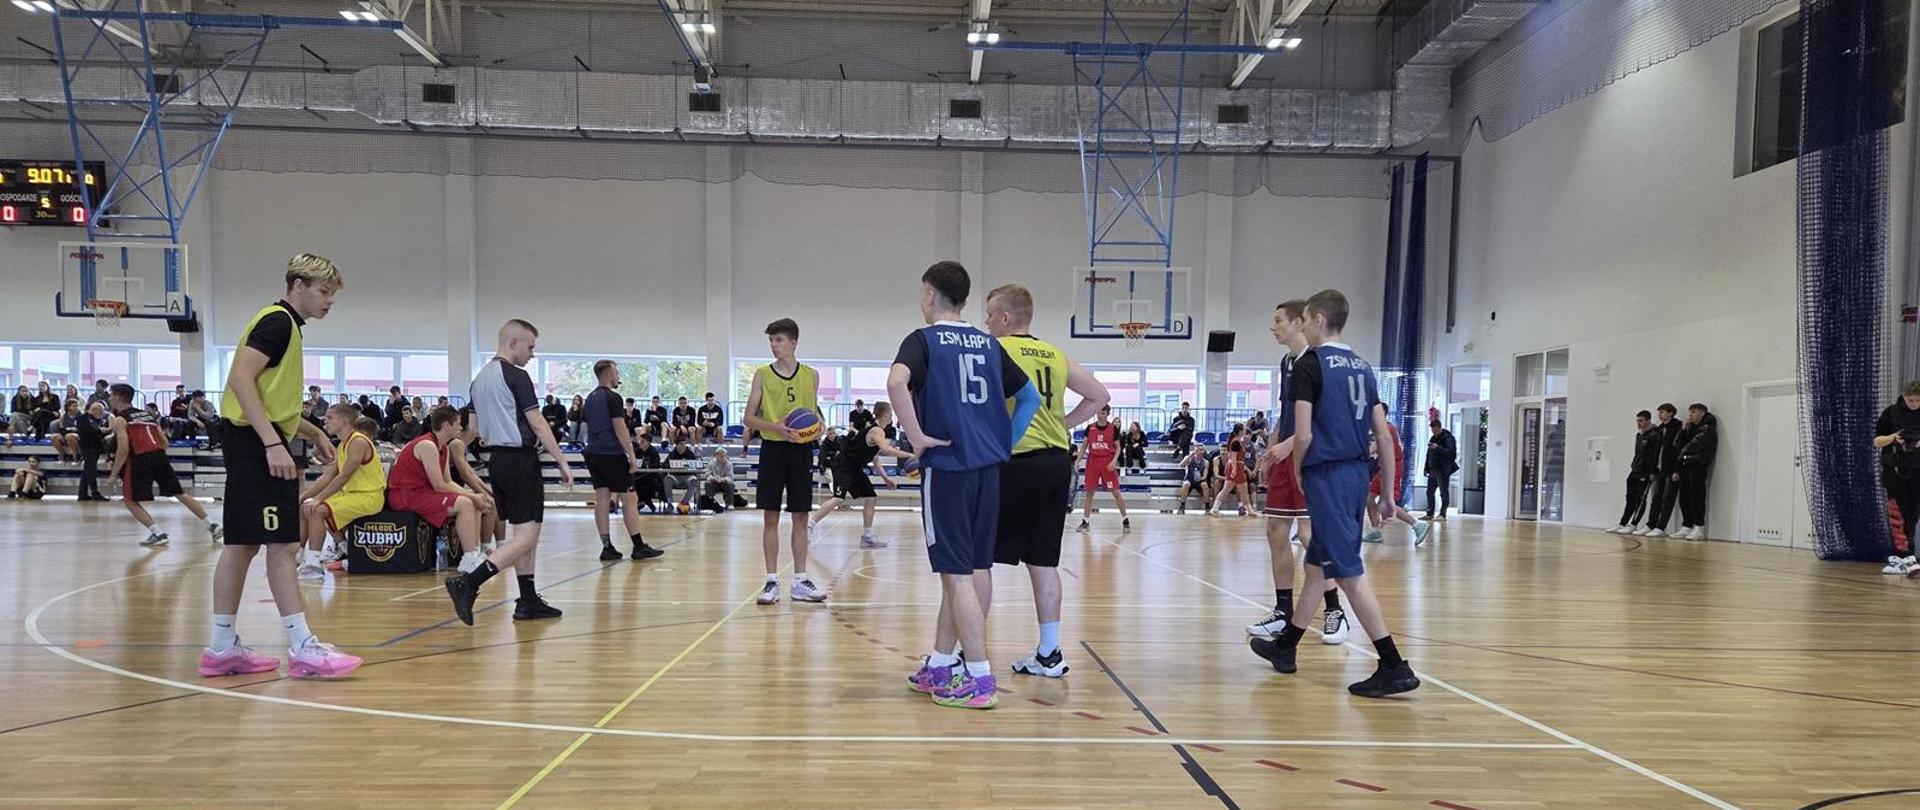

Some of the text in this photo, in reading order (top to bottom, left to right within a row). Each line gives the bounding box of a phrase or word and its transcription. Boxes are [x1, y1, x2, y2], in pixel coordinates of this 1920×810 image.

[0, 193, 38, 203] OSPODARZE
[170, 299, 181, 313] A
[1173, 320, 1184, 333] D
[937, 331, 992, 350] ZSM ŁAPY
[958, 353, 988, 405] 15
[1036, 366, 1053, 410] 4
[787, 386, 796, 403] 5
[1347, 373, 1368, 420] 4
[262, 506, 280, 531] 6
[357, 530, 403, 545] ZUBRY
